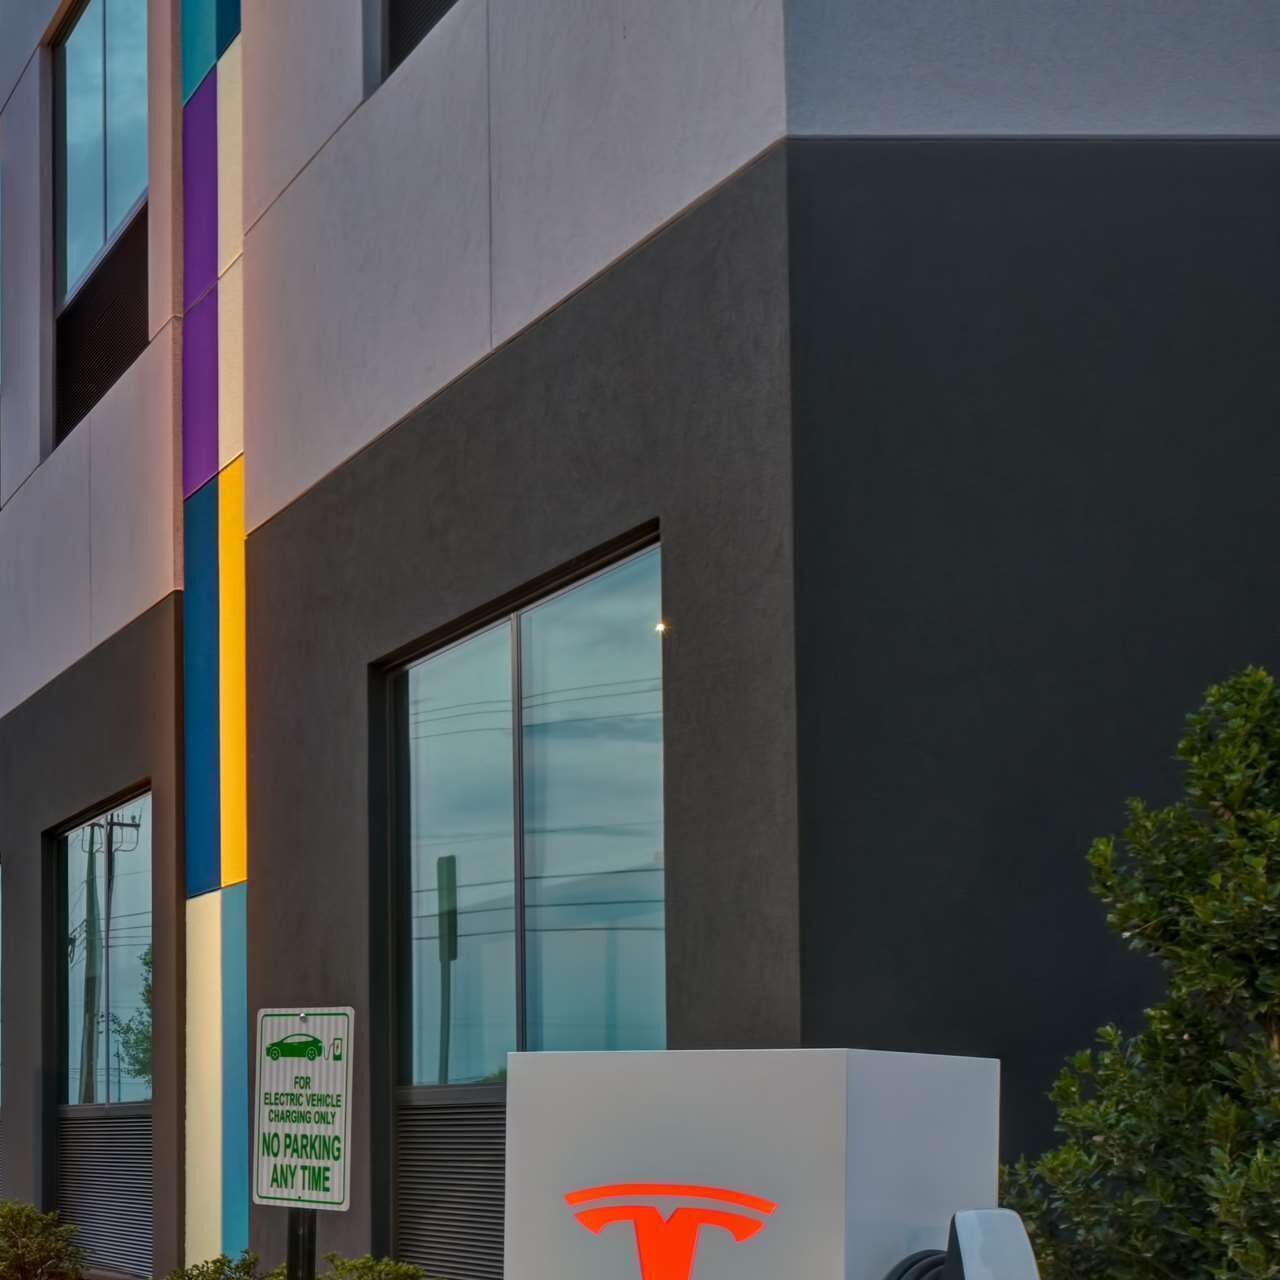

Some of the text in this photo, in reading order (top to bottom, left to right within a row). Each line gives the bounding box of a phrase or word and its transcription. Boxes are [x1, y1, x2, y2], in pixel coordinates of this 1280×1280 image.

[294, 1076, 311, 1090] FOR
[264, 1092, 342, 1108] ELECTRIC VEHICLE
[268, 1109, 337, 1125] CHARGING ONLY
[262, 1132, 341, 1161] NO PARKING
[270, 1163, 330, 1193] ANY TIME
